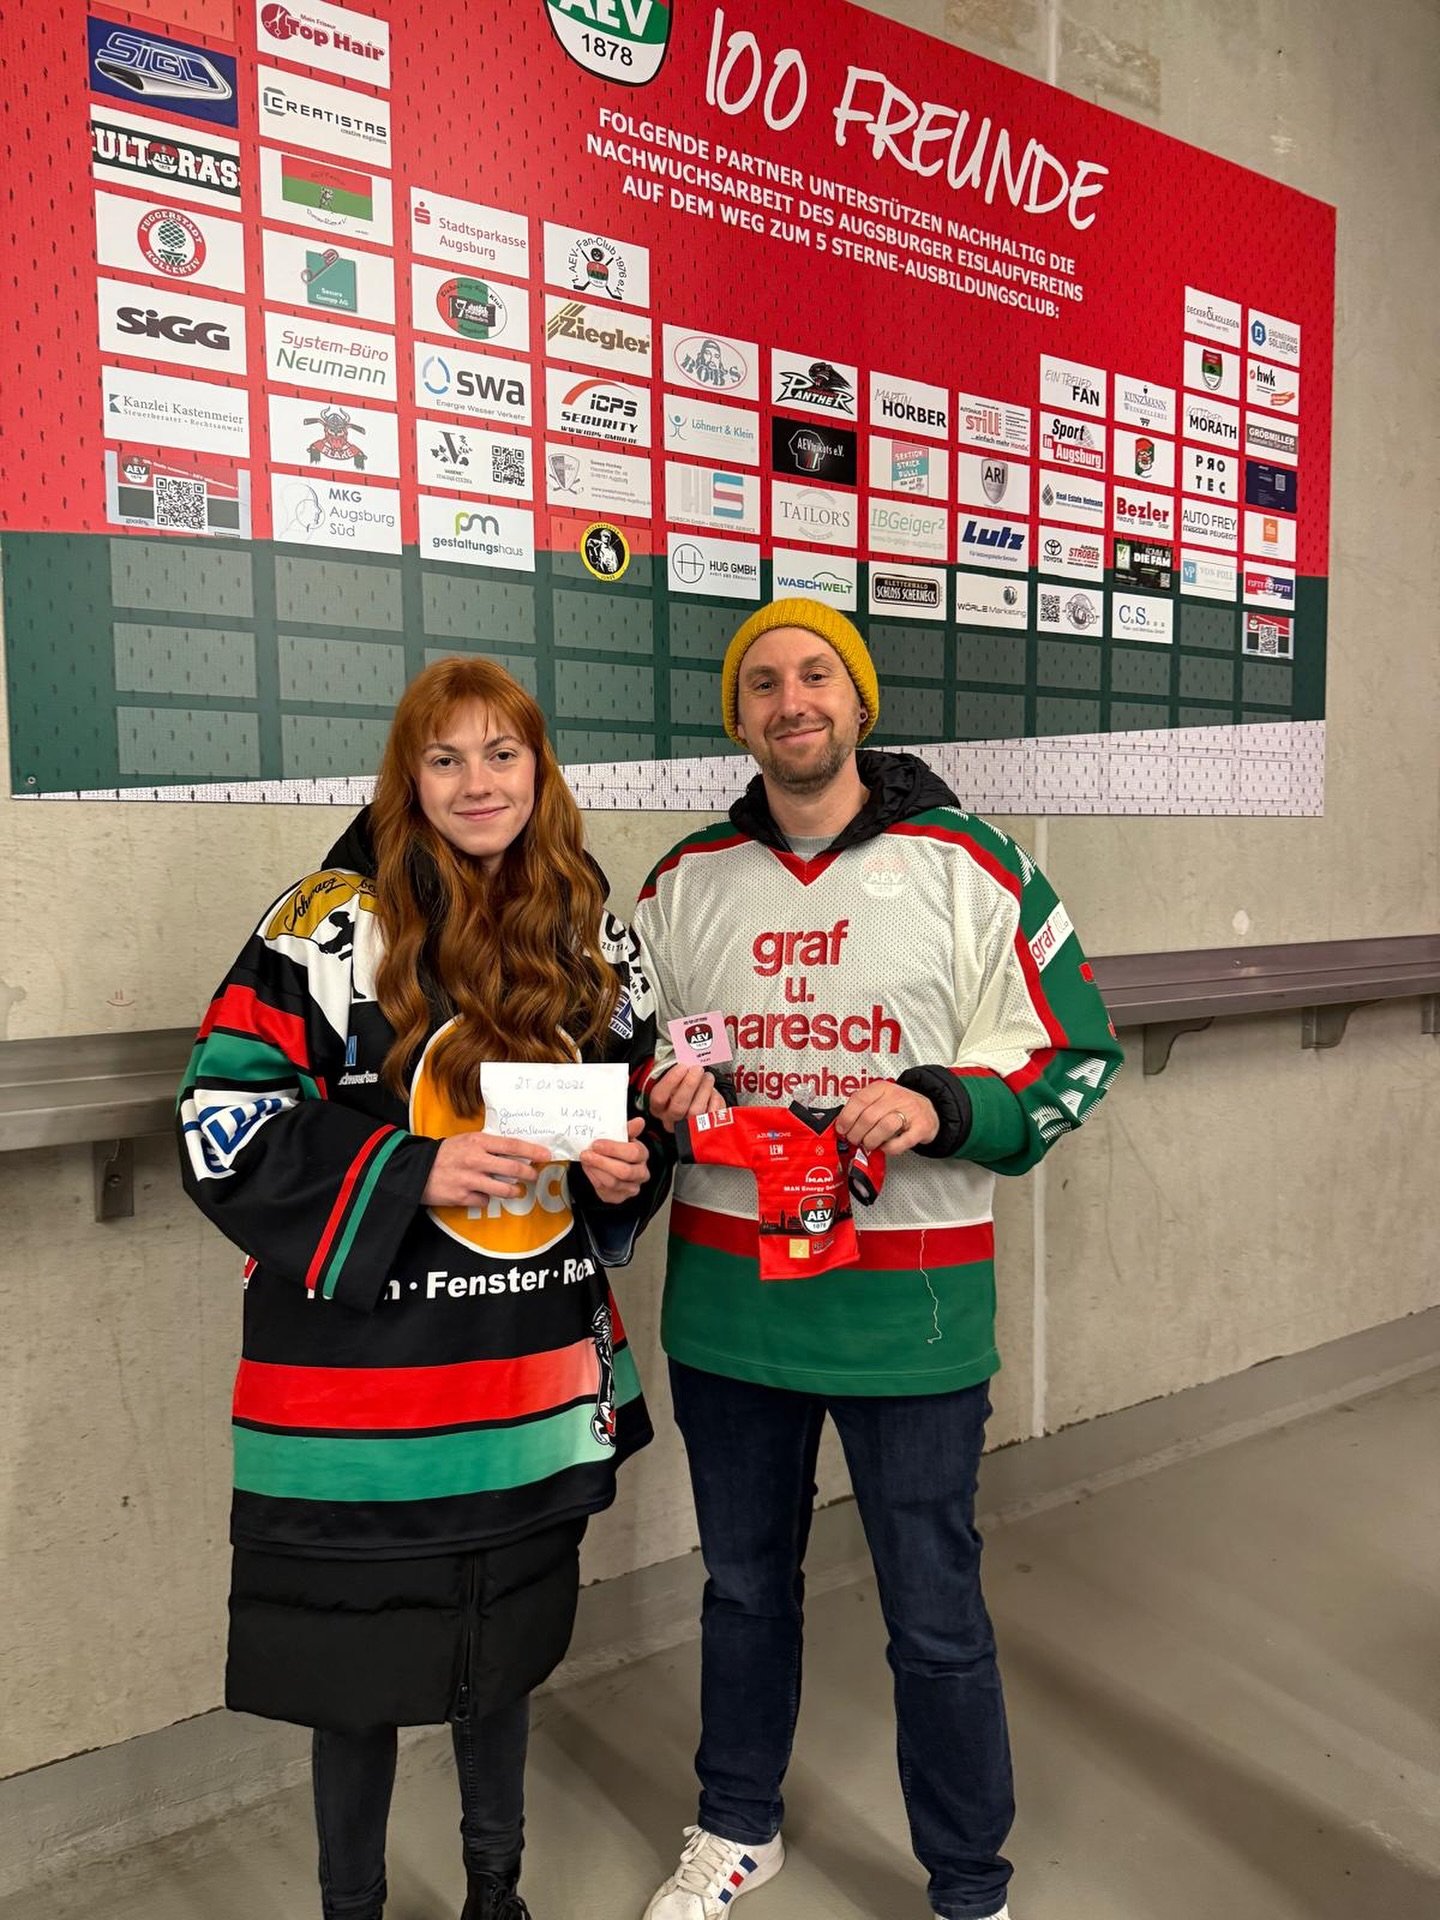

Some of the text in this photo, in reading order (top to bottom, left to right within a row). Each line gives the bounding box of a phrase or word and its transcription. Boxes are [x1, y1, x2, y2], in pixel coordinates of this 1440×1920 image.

[286, 17, 385, 61] Top Hair
[581, 33, 633, 67] 1878
[98, 31, 211, 87] SIGL
[271, 96, 388, 138] CREATISTAS
[705, 8, 1109, 230] 100 FREUNDE
[153, 152, 175, 164] AEV
[599, 107, 1076, 275] FOLGENDE PARTNER UNTERSTÜTZEN NACHHALTIG DIE
[140, 210, 204, 244] FUGGERSTADT
[586, 133, 1084, 302] NACHWUCHSARBEIT DES AUGSBURGER EISLAUFVEREINS
[438, 217, 527, 249] Stadtsparkasse
[439, 235, 496, 260] Augsburg
[622, 175, 1060, 319] AUF DEM WEG ZUM 5 STERNE-AUSBILDUNGSCLUB:
[146, 249, 201, 275] KOLLEKTIV
[615, 256, 628, 279] 1976
[116, 306, 230, 351] SiGG
[558, 314, 651, 355] Ziegler
[281, 330, 389, 362] System-Büro
[276, 347, 386, 386] Neumann
[1256, 364, 1276, 387] hwk
[455, 369, 525, 407] swa
[775, 371, 856, 415] PANTHER
[1072, 385, 1100, 407] FAN
[123, 395, 244, 425] Kanzlei Kastenmeier
[436, 398, 465, 412] Energie
[467, 404, 495, 417] Wasser
[560, 410, 639, 434] SECURITY
[733, 427, 754, 440] Klein
[1051, 418, 1085, 441] Sport
[1189, 414, 1238, 440] MORATH
[1044, 435, 1053, 448] in
[1055, 443, 1102, 469] Augsburg
[126, 464, 146, 475] AEV
[984, 465, 1005, 484] ARI
[328, 487, 362, 503] MKG
[1195, 475, 1226, 494] TEC
[329, 505, 395, 528] Augsburg
[1116, 496, 1170, 523] Bezler
[1182, 508, 1237, 531] AUTO FREY
[329, 521, 356, 537] Süd
[962, 519, 1026, 551] Lutz
[1209, 529, 1238, 541] PEUGEOT
[432, 536, 524, 557] gestaltungshaus
[1133, 551, 1150, 564] DIE
[709, 560, 757, 576] HUG GMBH
[1043, 555, 1063, 565] TOYOTA
[776, 576, 854, 594] WASCHWELT
[876, 585, 901, 600] SCHLOSS
[884, 579, 929, 590] KLETTERWALD
[752, 919, 850, 977] graf
[1030, 924, 1057, 965] graf
[784, 978, 815, 1003] u.
[690, 1032, 710, 1044] AEV
[807, 1208, 832, 1222] AEV
[426, 1265, 549, 1300] Fenster
